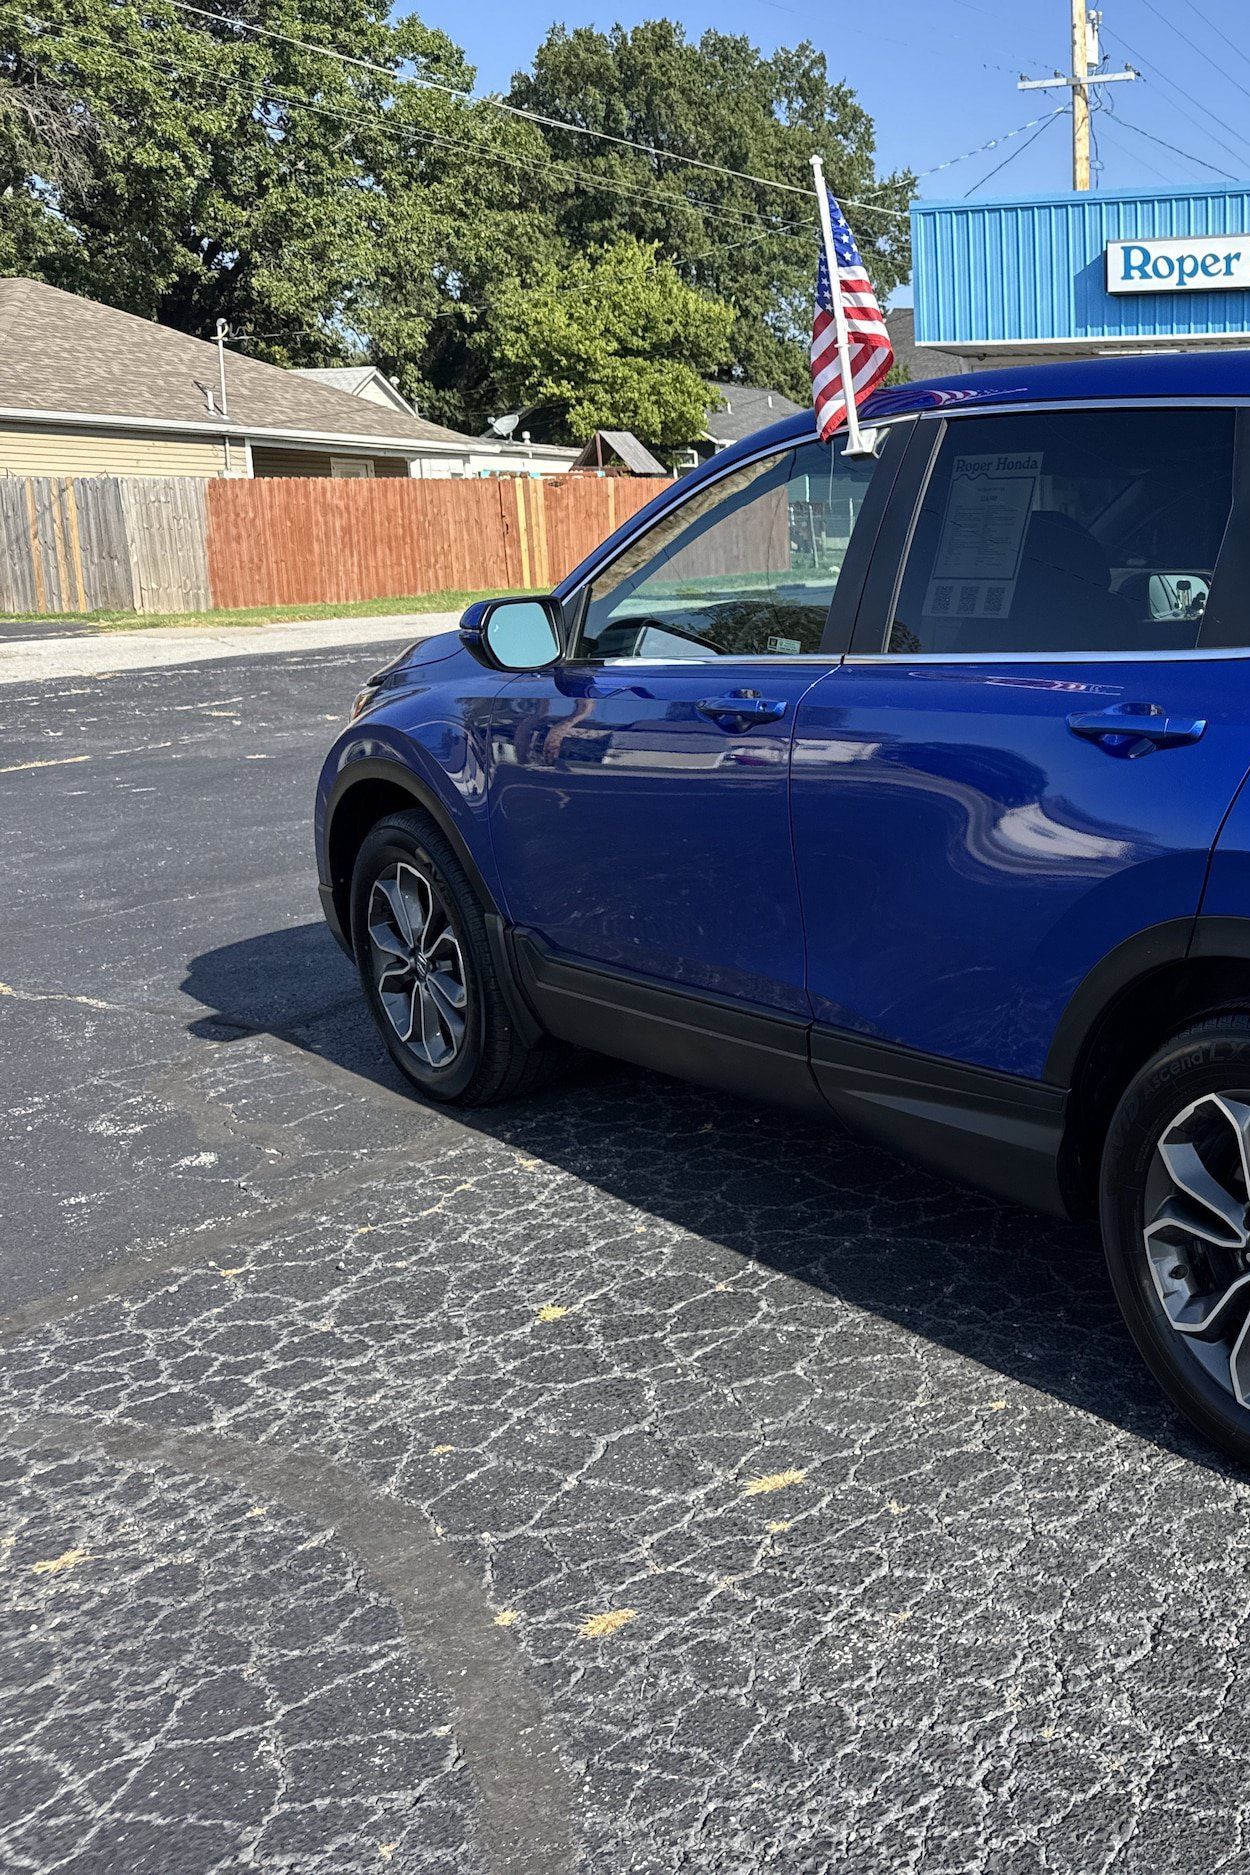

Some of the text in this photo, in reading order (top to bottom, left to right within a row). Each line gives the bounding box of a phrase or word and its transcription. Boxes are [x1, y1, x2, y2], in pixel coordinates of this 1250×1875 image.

[1120, 245, 1241, 287] Roper
[955, 456, 1039, 474] Roper Honda
